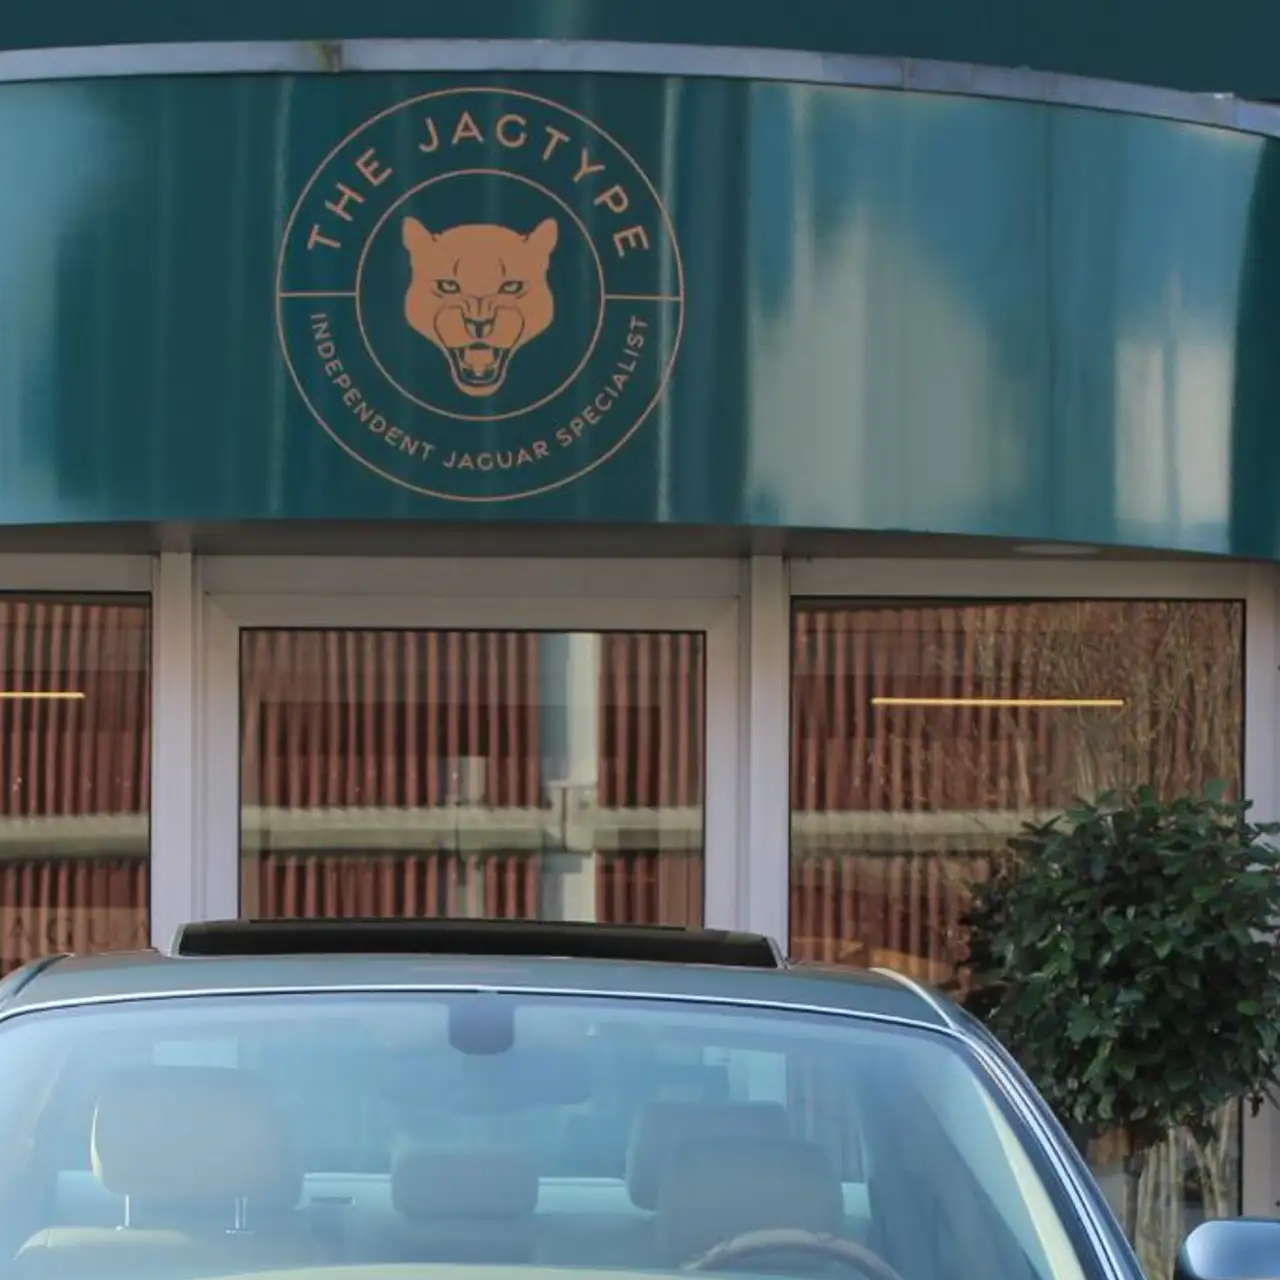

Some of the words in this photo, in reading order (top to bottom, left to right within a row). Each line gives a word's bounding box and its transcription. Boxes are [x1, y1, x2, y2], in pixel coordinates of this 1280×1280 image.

[307, 148, 394, 252] THE
[418, 110, 650, 257] JAGTYPE
[310, 312, 435, 460] INDEPENDENT
[443, 441, 549, 471] JAGUAR
[556, 315, 649, 449] SPECIALIST
